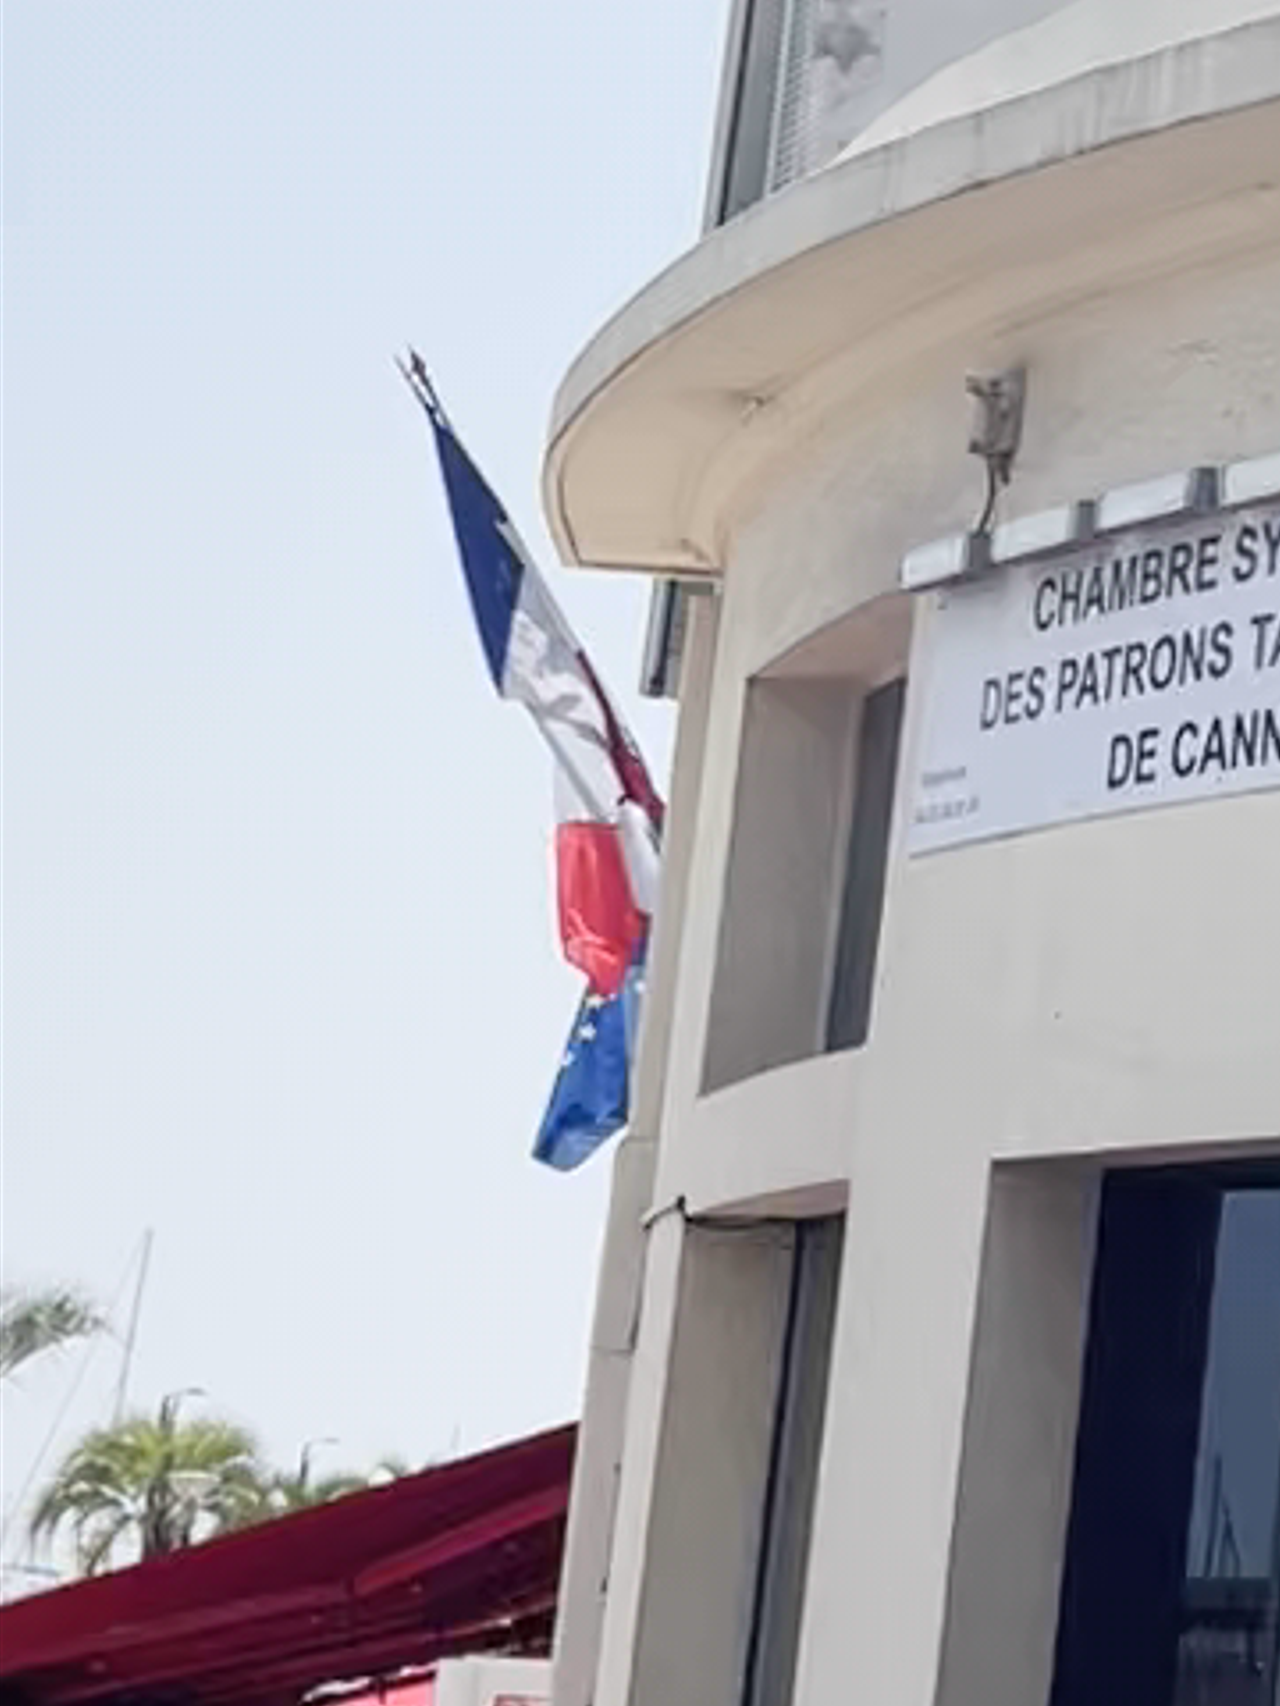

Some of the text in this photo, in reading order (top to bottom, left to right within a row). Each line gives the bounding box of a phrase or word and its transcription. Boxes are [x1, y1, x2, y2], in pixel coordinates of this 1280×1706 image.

[1033, 533, 1222, 632] CHAMBRE
[979, 665, 1046, 731] DES
[1054, 620, 1234, 714] PATRONS
[1107, 726, 1161, 790] DE
